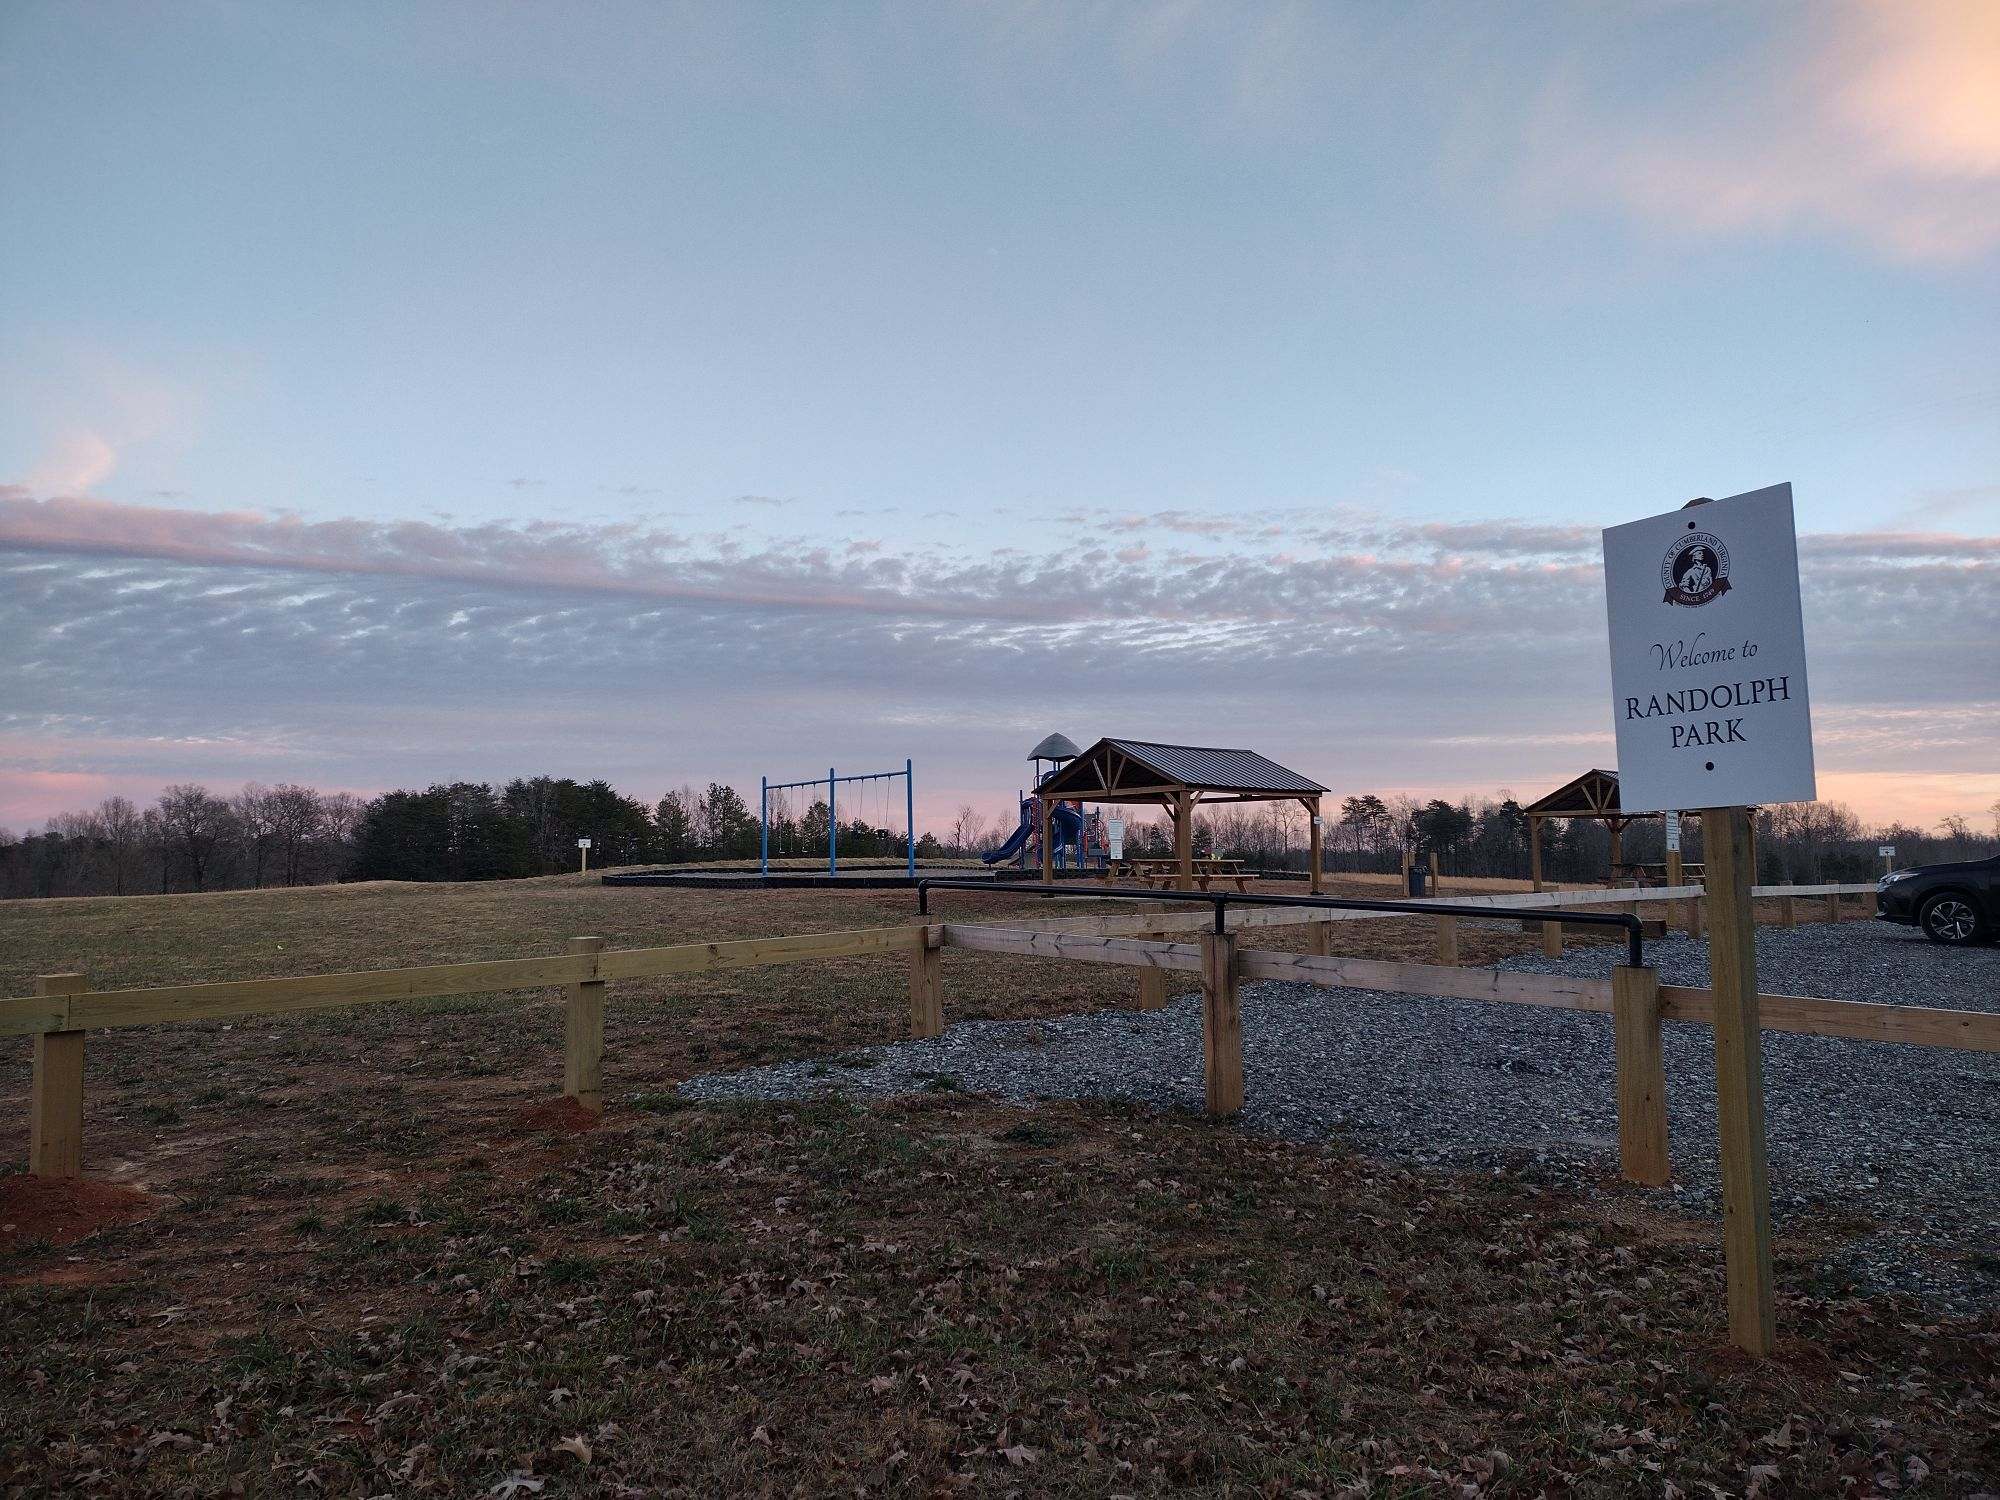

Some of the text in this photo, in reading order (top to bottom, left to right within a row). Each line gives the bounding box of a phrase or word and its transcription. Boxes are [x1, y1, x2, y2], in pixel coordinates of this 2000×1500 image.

[1663, 535, 1728, 588] COUNTY OF CUMBERLAND VIRGINIA
[1680, 593, 1701, 602] SINCE
[1649, 632, 1758, 671] Welcome to
[1625, 676, 1791, 720] RANDOLPH
[1671, 718, 1747, 748] PARK
